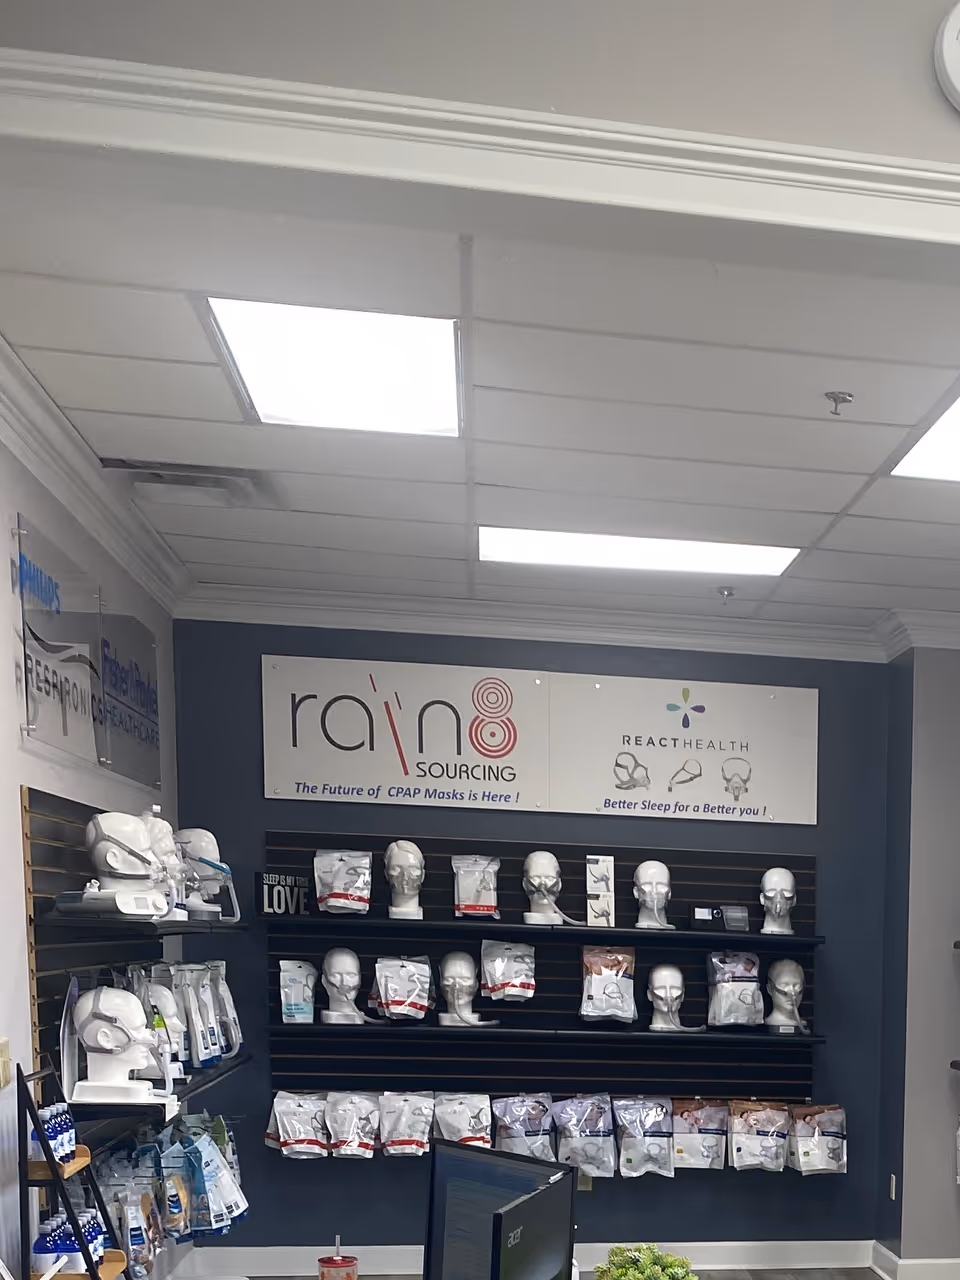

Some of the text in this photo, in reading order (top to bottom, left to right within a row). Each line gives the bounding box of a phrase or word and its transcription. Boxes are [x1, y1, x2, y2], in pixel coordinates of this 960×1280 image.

[416, 761, 517, 782] SOURCING
[295, 782, 318, 794] The
[321, 783, 364, 796] Future
[367, 785, 382, 799] of
[387, 786, 421, 798] CPAP
[424, 788, 465, 801] Masks
[468, 789, 478, 801] is
[481, 790, 511, 803] Here
[603, 798, 639, 810] Better
[640, 800, 671, 814] Sleep
[673, 802, 690, 813] for
[692, 805, 700, 813] a
[702, 803, 738, 815] Better
[739, 806, 760, 817] you
[263, 873, 280, 885] SLEEP
[280, 875, 286, 886] IS
[286, 875, 295, 886] MY
[263, 885, 309, 915] LOVE
[507, 1225, 523, 1248] acer
